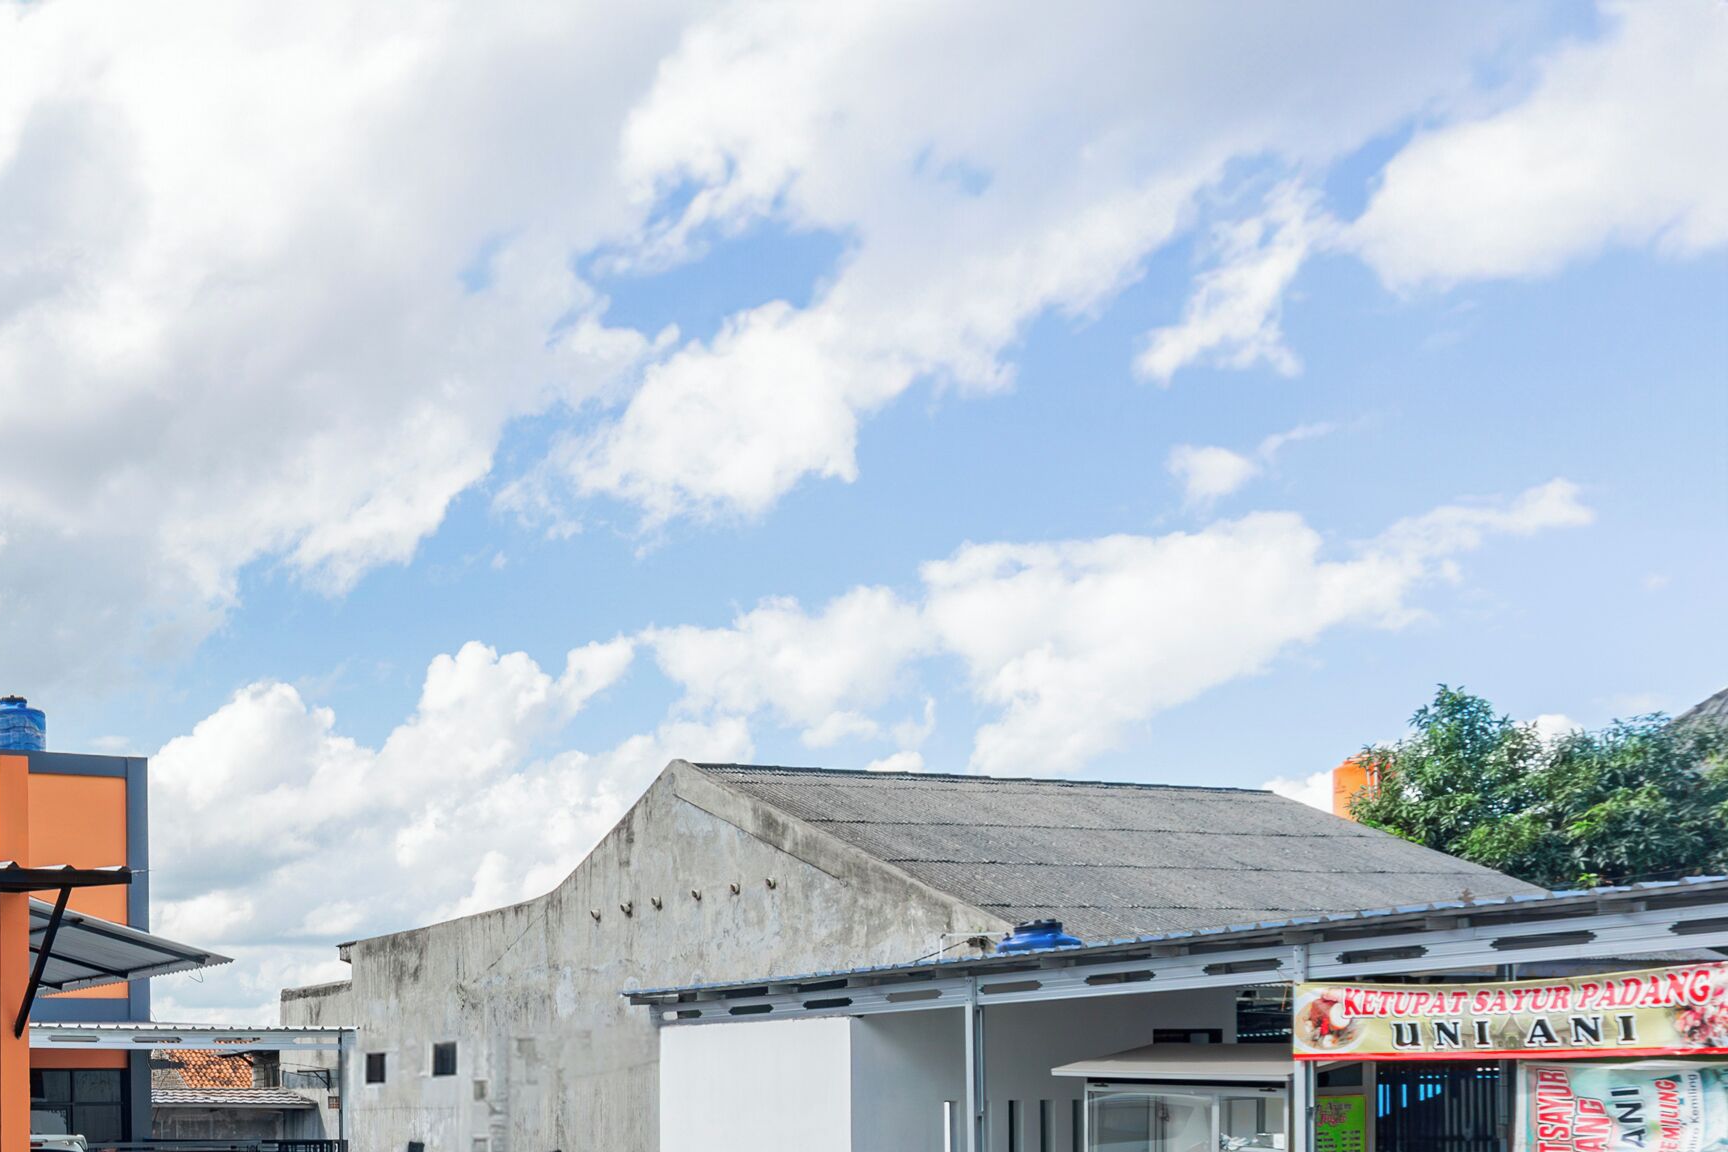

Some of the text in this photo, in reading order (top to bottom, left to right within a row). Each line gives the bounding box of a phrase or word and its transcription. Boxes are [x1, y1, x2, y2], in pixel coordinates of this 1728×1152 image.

[1342, 969, 1712, 1018] KETUPAT SAYUR PADANG
[1392, 1013, 1639, 1048] UNI ANI
[1537, 1069, 1574, 1140] SAYUR
[1610, 1087, 1647, 1149] ANI
[1686, 1074, 1699, 1124] Kemiling
